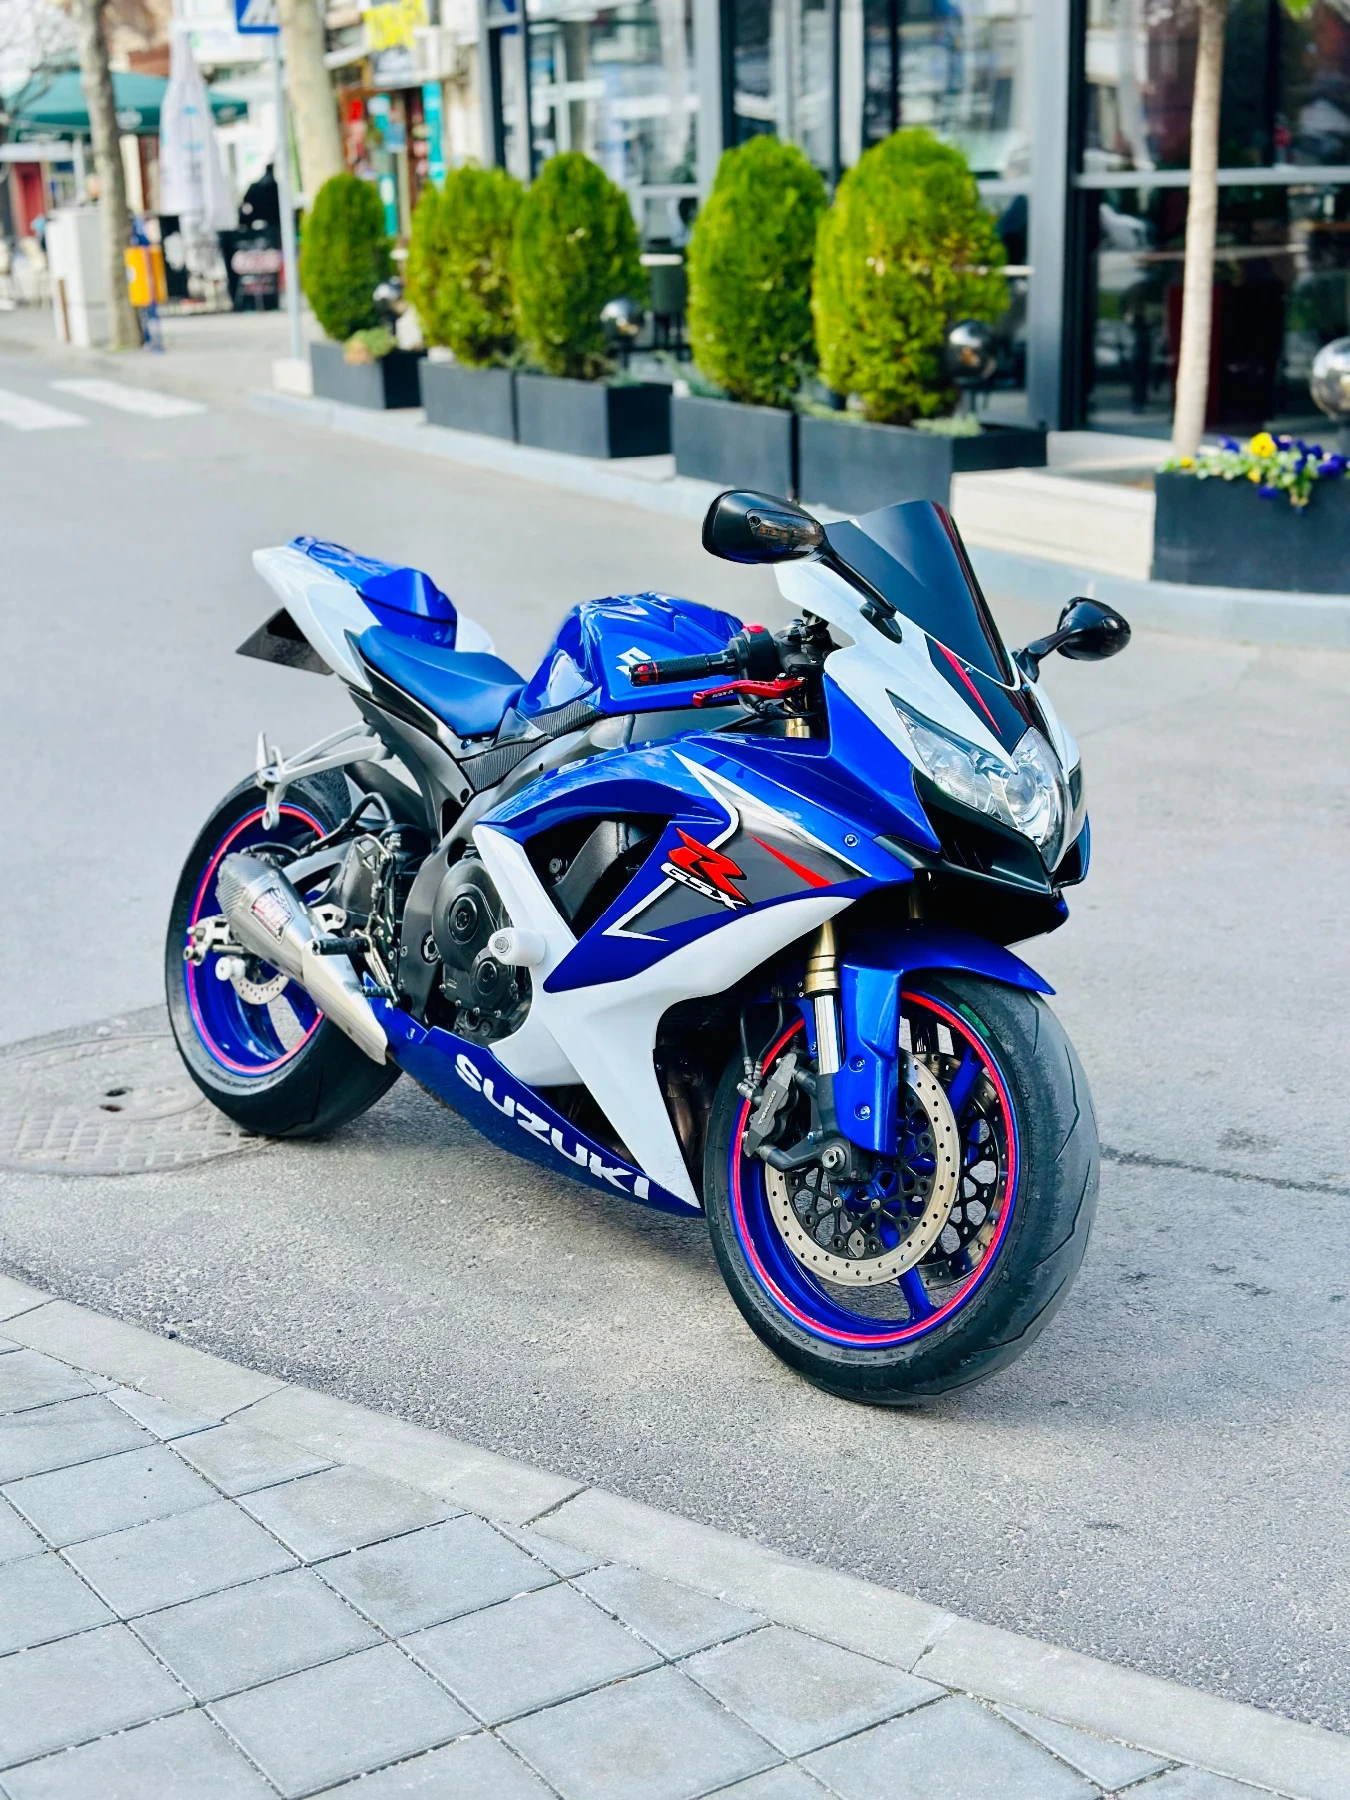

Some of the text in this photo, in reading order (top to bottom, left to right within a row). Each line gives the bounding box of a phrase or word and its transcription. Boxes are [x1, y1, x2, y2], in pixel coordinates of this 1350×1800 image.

[660, 862, 747, 911] GSX
[455, 1053, 650, 1200] SUZUKI
[757, 1089, 777, 1124] TOKICO
